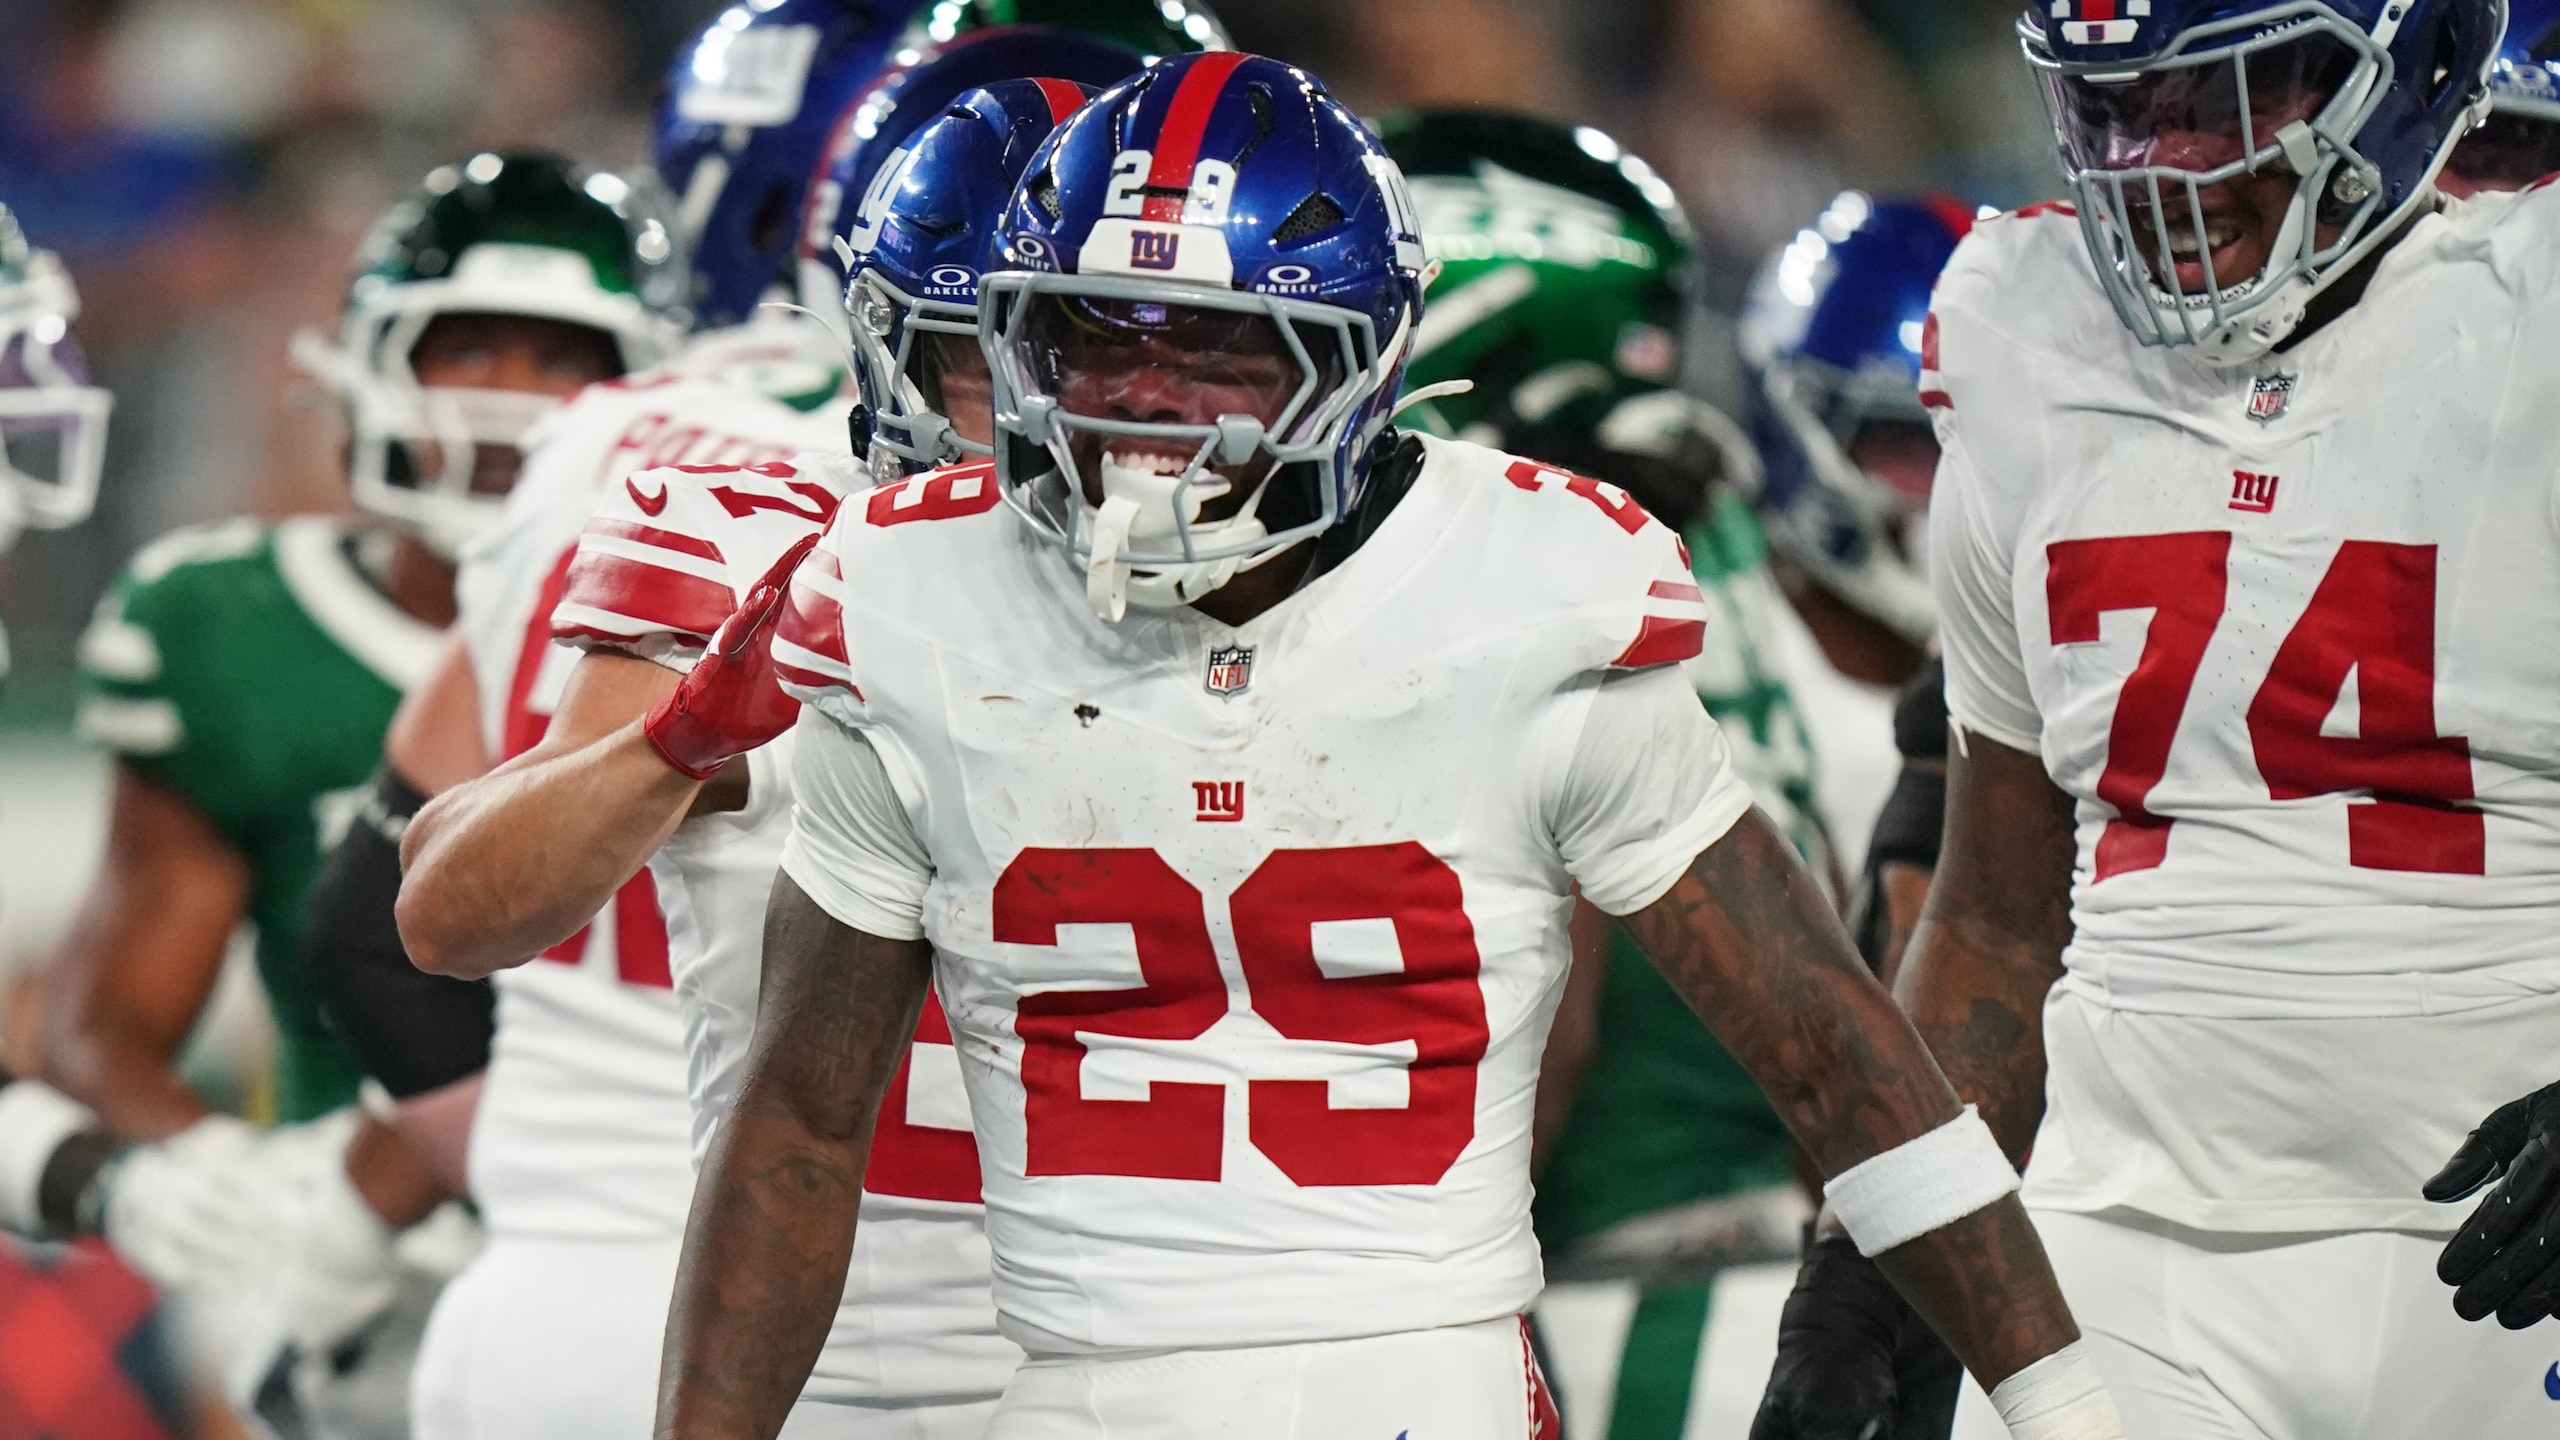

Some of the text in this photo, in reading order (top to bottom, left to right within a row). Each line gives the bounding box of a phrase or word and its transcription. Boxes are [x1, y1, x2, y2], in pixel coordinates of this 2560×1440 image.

[923, 286, 980, 296] OAKLEY
[1255, 283, 1319, 294] OAKLEY
[2252, 392, 2283, 415] NFL
[1211, 665, 1247, 690] NFL
[2045, 530, 2487, 884] 74
[992, 840, 1491, 1188] 29
